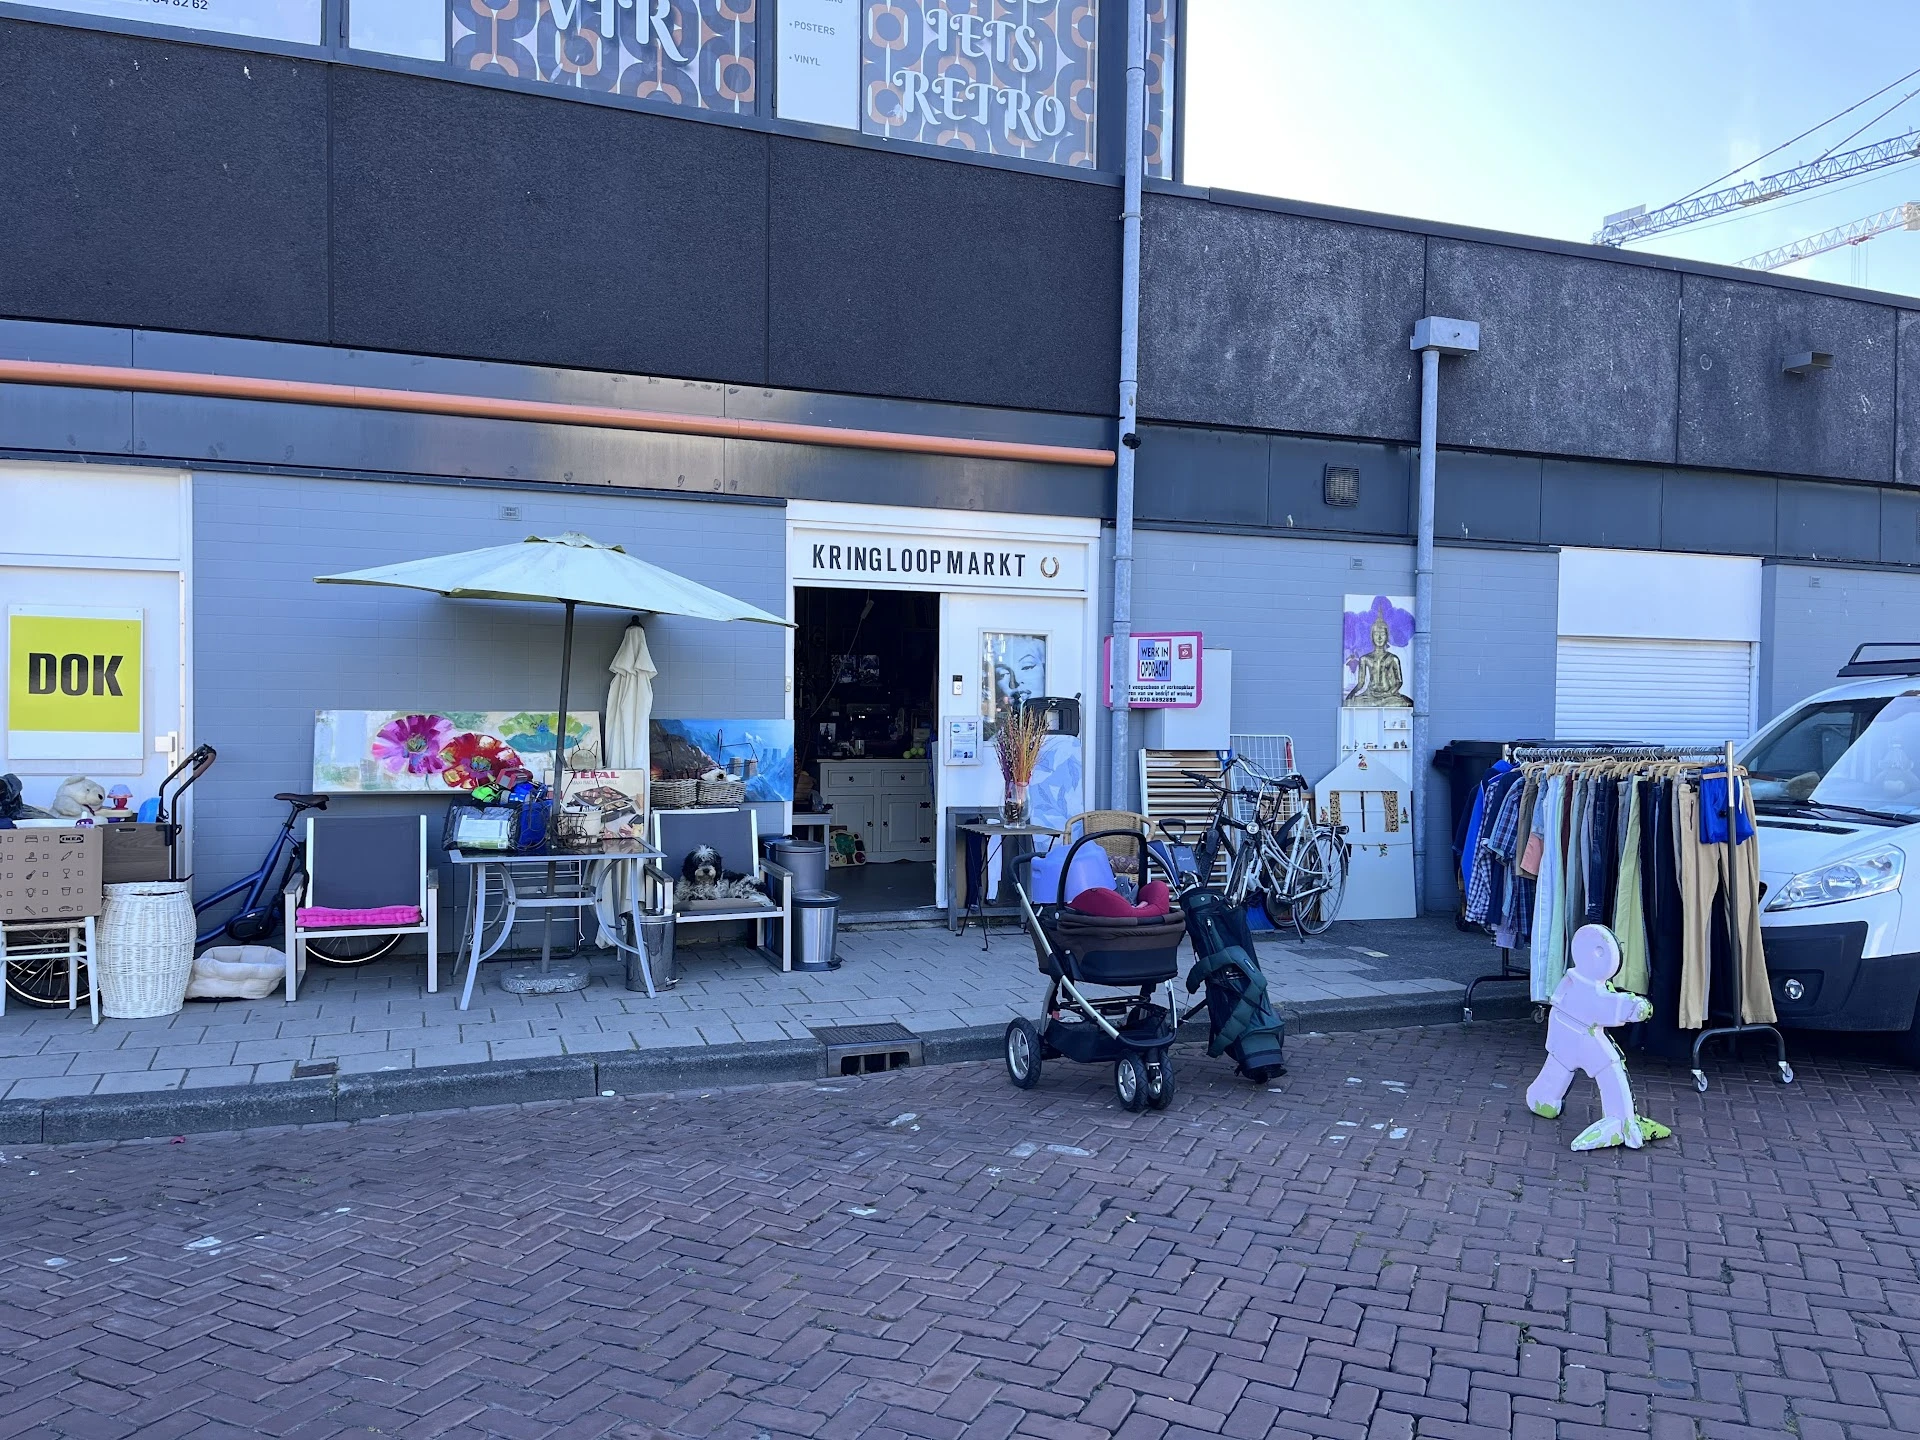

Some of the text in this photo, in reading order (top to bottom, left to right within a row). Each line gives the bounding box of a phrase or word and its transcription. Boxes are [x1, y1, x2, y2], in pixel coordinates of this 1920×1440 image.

[192, 0, 208, 10] 62
[795, 21, 835, 35] POSTERS
[926, 8, 1037, 73] IETS
[794, 54, 821, 66] VINYL
[893, 69, 1066, 142] RETRO
[812, 543, 1026, 577] KRINGLOOPMARKT
[1141, 647, 1168, 657] WERK IN
[28, 652, 124, 697] DOK
[1141, 661, 1169, 677] OPDRACHT
[570, 770, 619, 779] TEFAL
